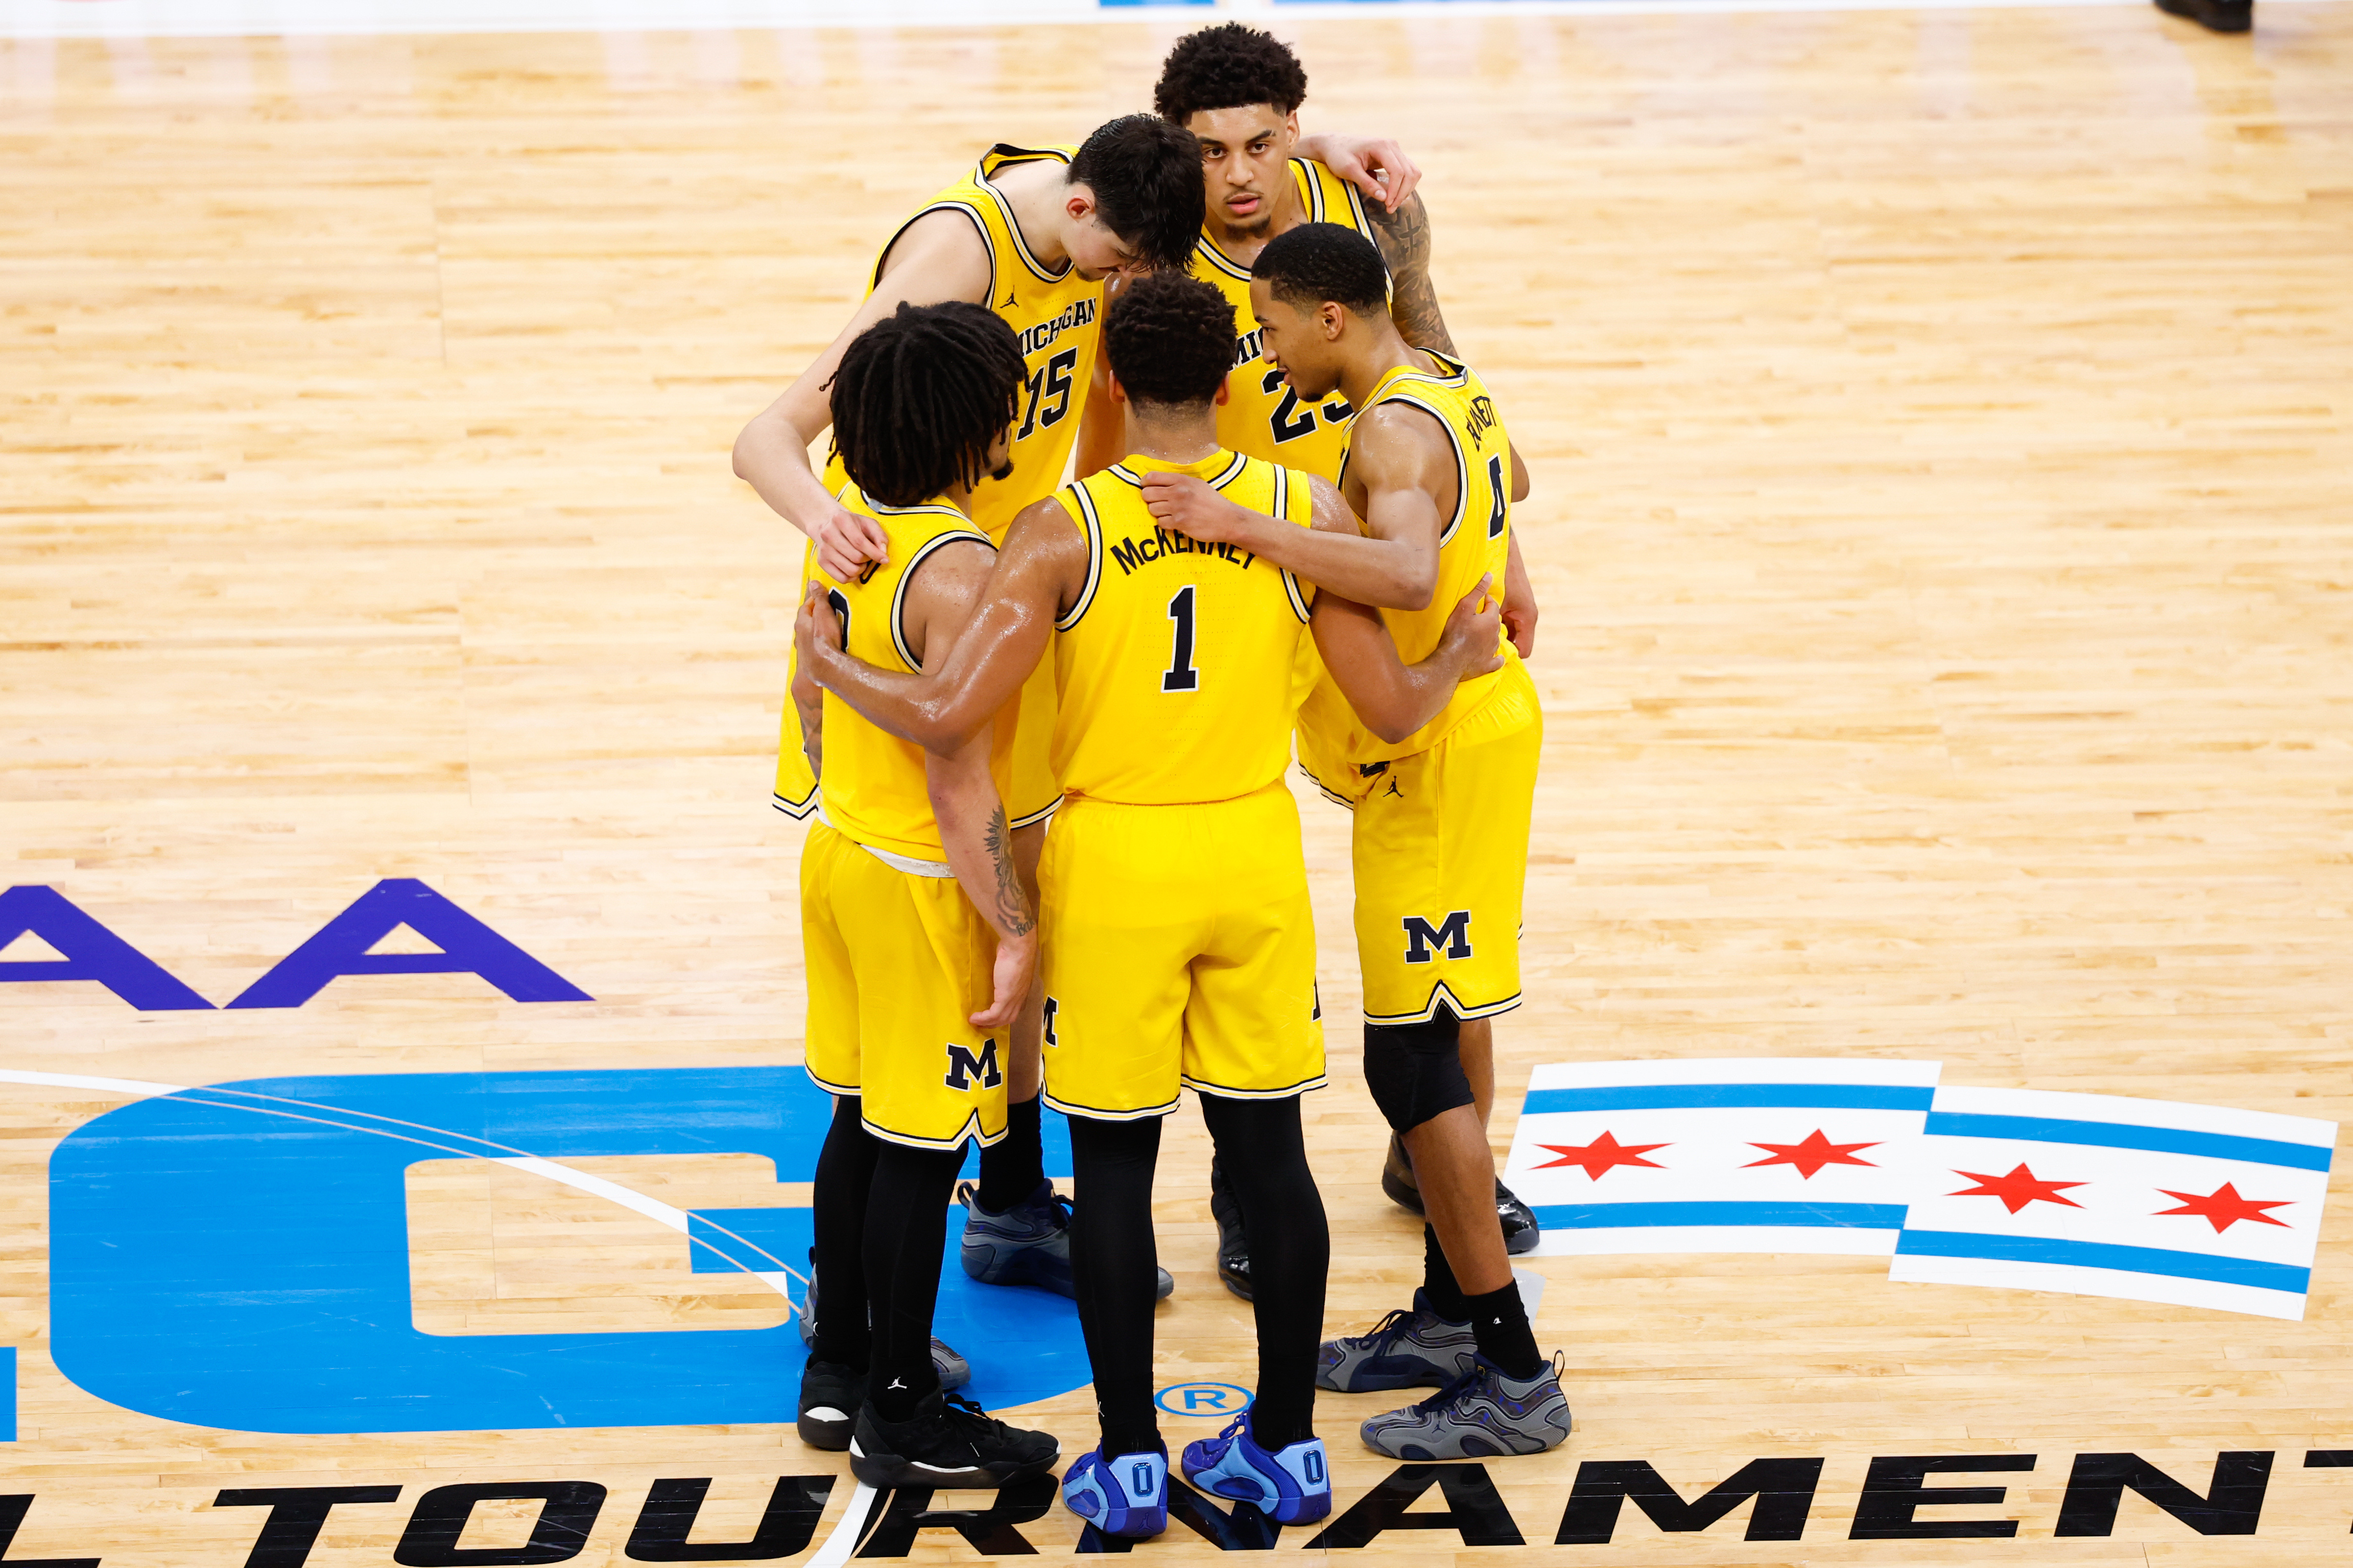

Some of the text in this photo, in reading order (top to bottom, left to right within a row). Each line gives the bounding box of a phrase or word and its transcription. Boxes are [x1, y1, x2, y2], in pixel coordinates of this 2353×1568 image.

[1016, 345, 1079, 443] 15
[1160, 584, 1200, 693] 1
[1401, 909, 1473, 964] M
[943, 1037, 1003, 1092] M
